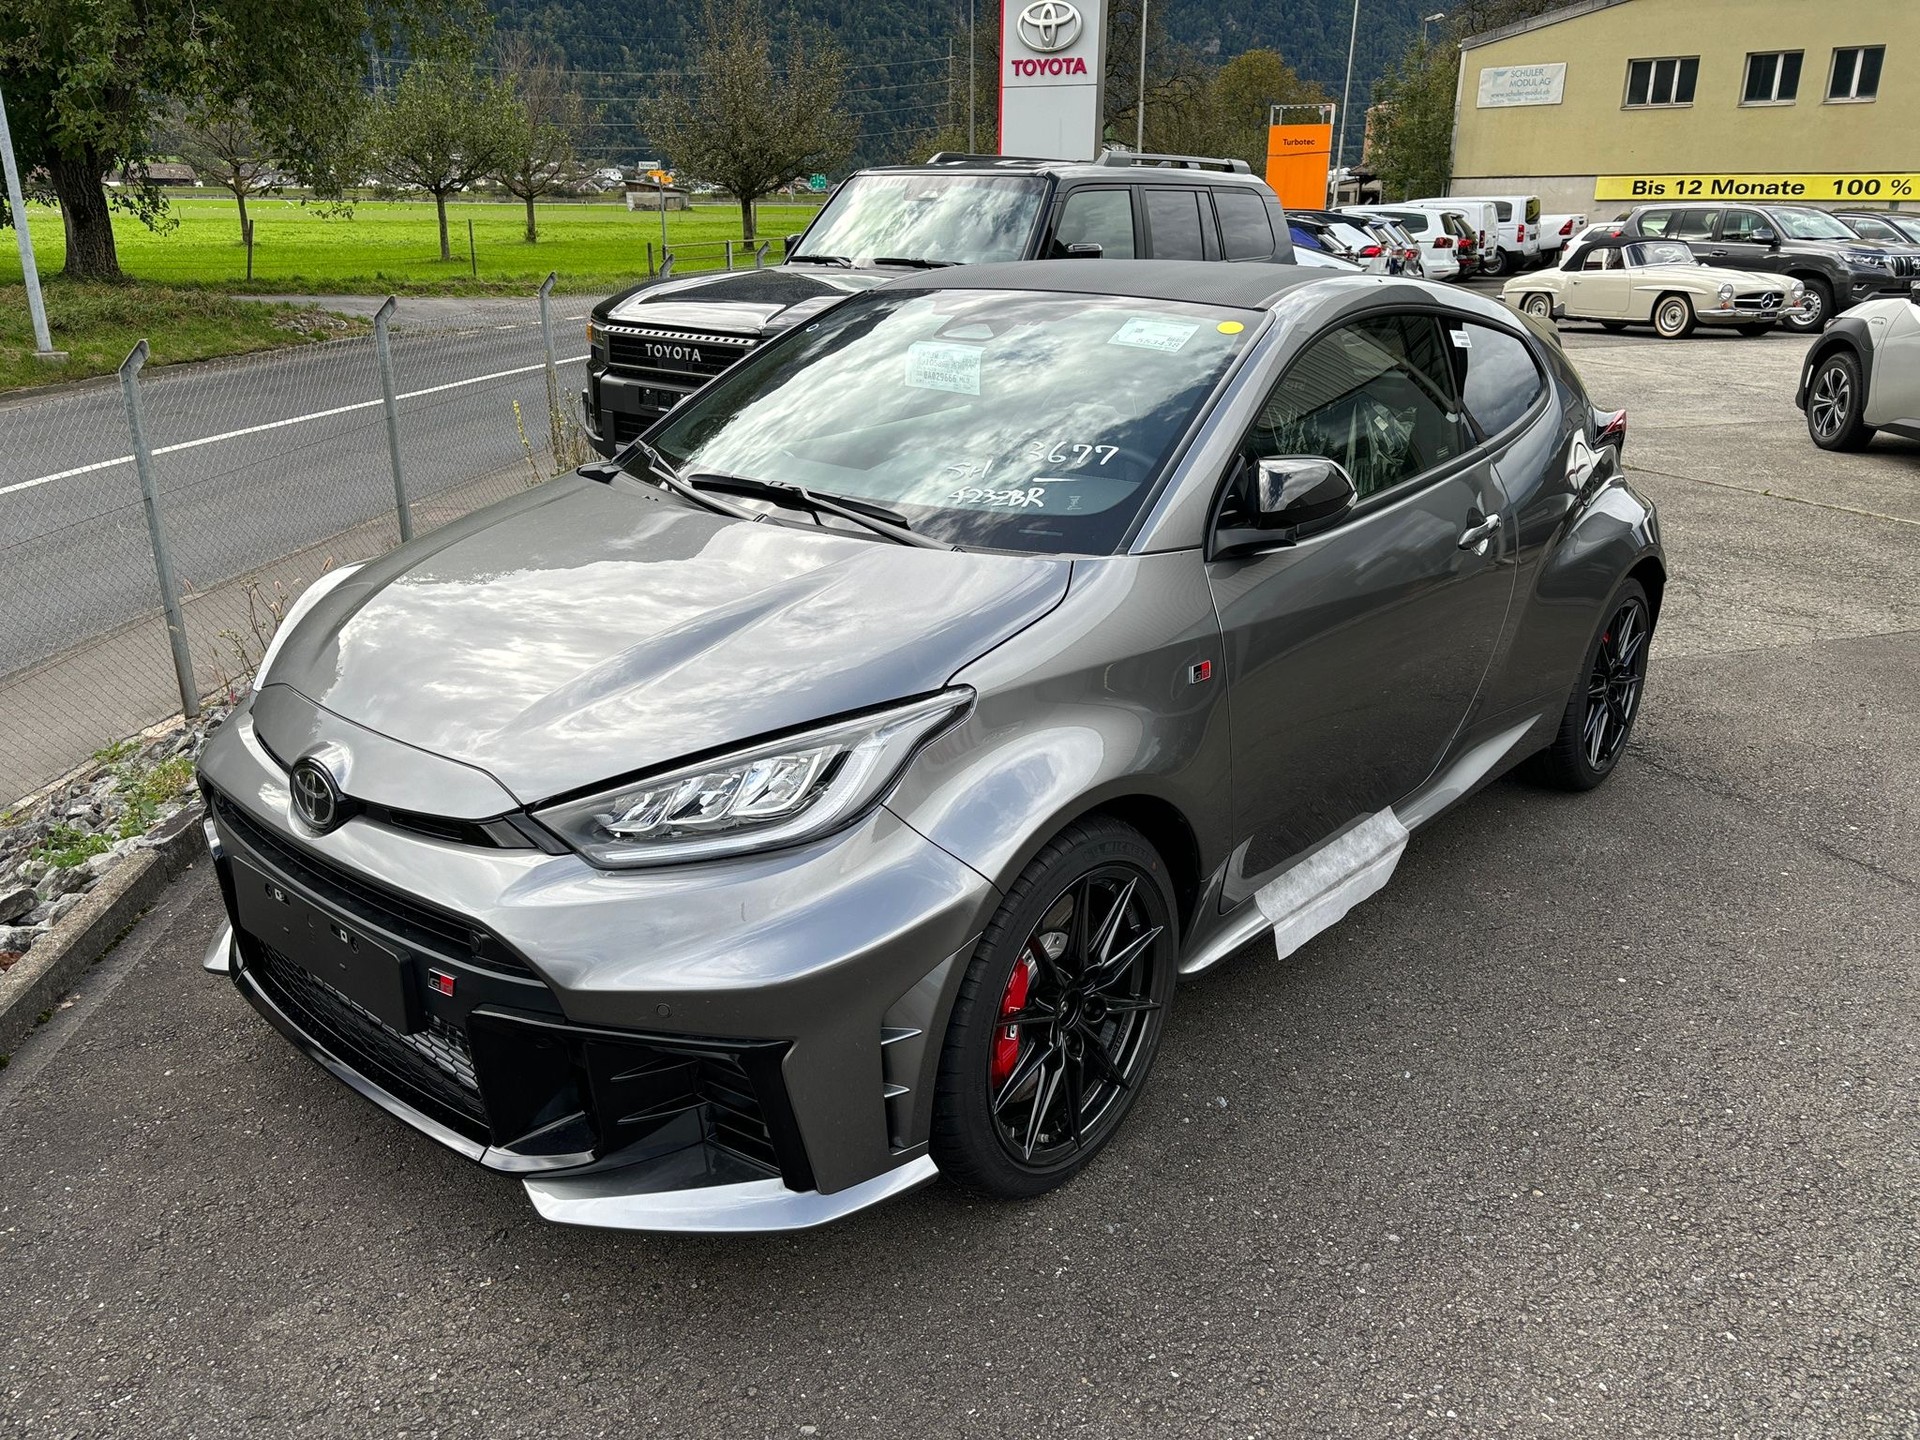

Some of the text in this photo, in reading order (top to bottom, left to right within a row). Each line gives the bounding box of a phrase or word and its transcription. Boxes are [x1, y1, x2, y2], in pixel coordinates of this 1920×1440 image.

[1011, 57, 1088, 76] TOYOTA
[1508, 77, 1551, 88] MODUL AG
[1282, 138, 1316, 146] Turbotec
[1631, 179, 1912, 195] Bis 12 Monate 100 %
[645, 343, 702, 362] TOYOTA
[1029, 441, 1120, 466] 3677
